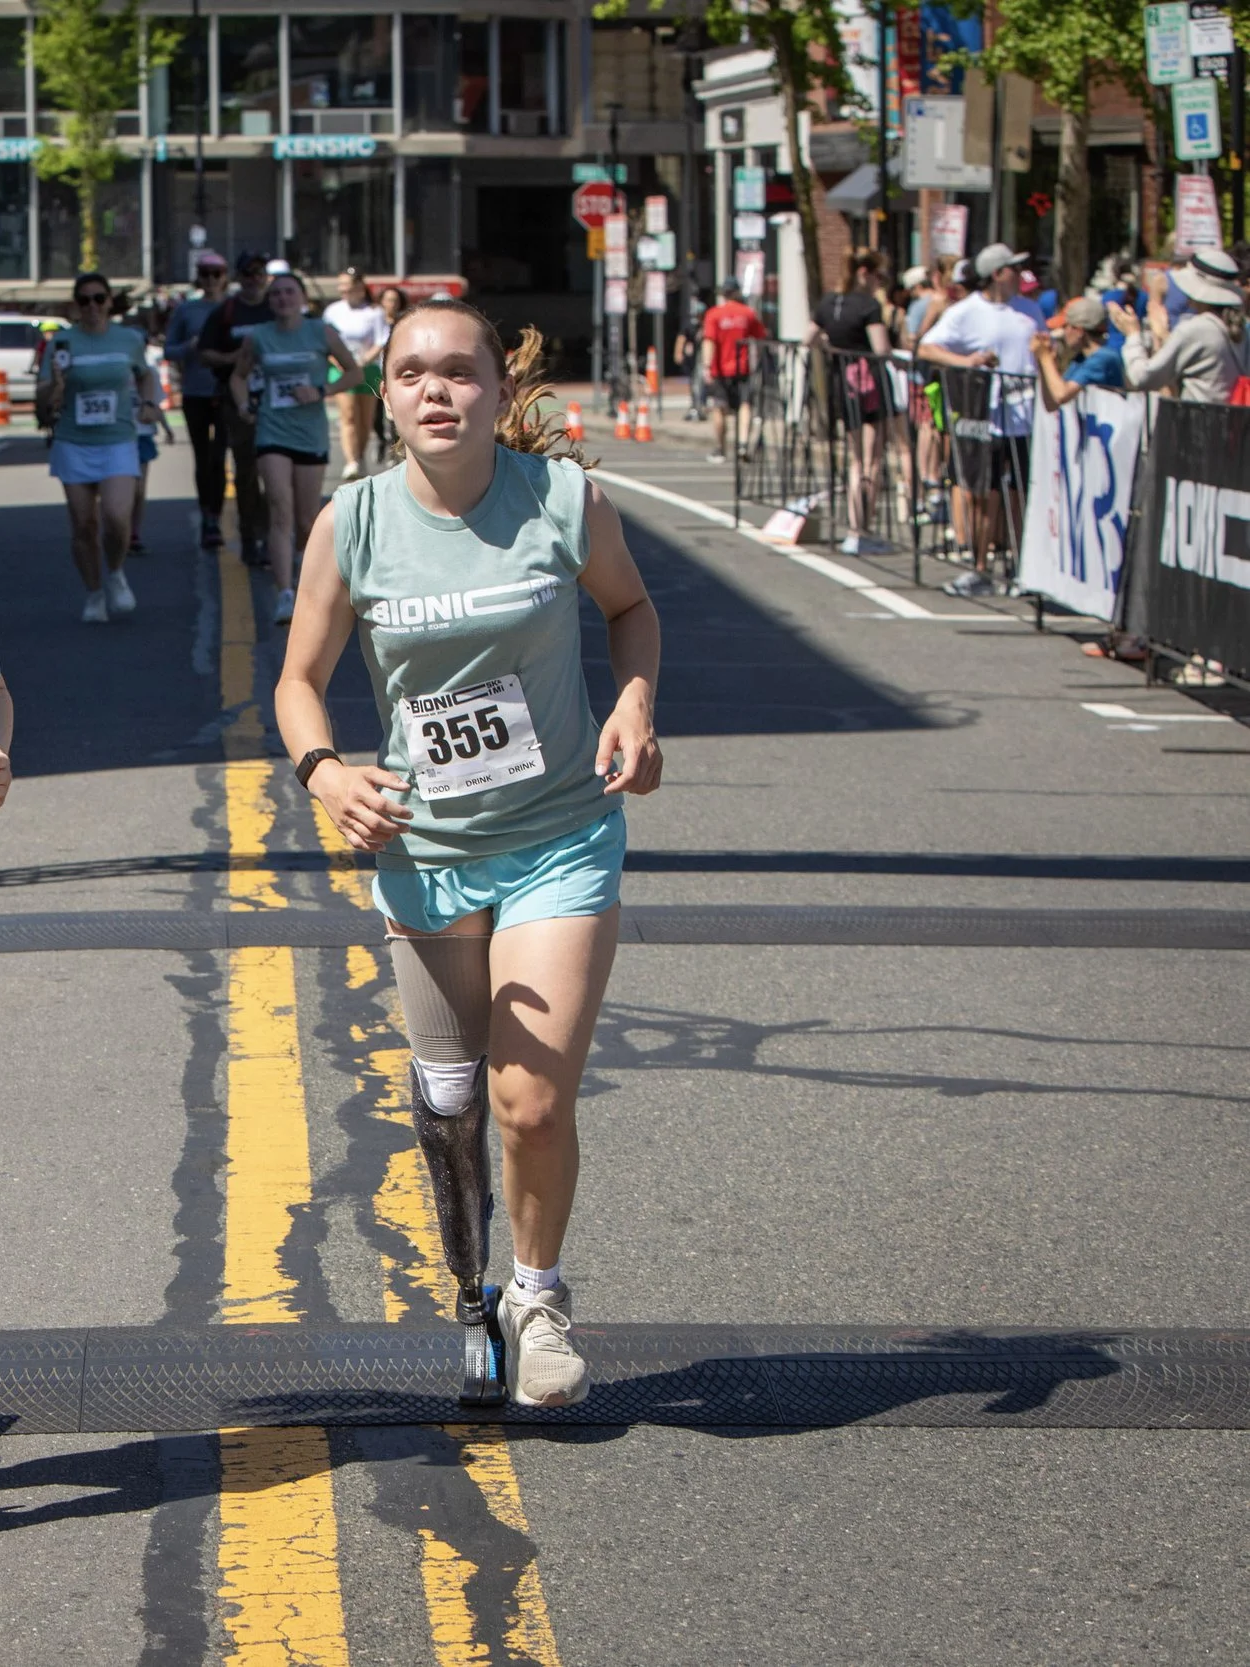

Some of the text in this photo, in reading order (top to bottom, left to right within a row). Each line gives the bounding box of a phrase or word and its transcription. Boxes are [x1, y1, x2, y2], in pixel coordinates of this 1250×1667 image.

[275, 138, 373, 158] KENSHO
[372, 580, 533, 626] BIONIC
[410, 683, 489, 714] BIONIC
[422, 704, 510, 765] 355
[427, 760, 537, 795] FOOD DRINK DRINK
